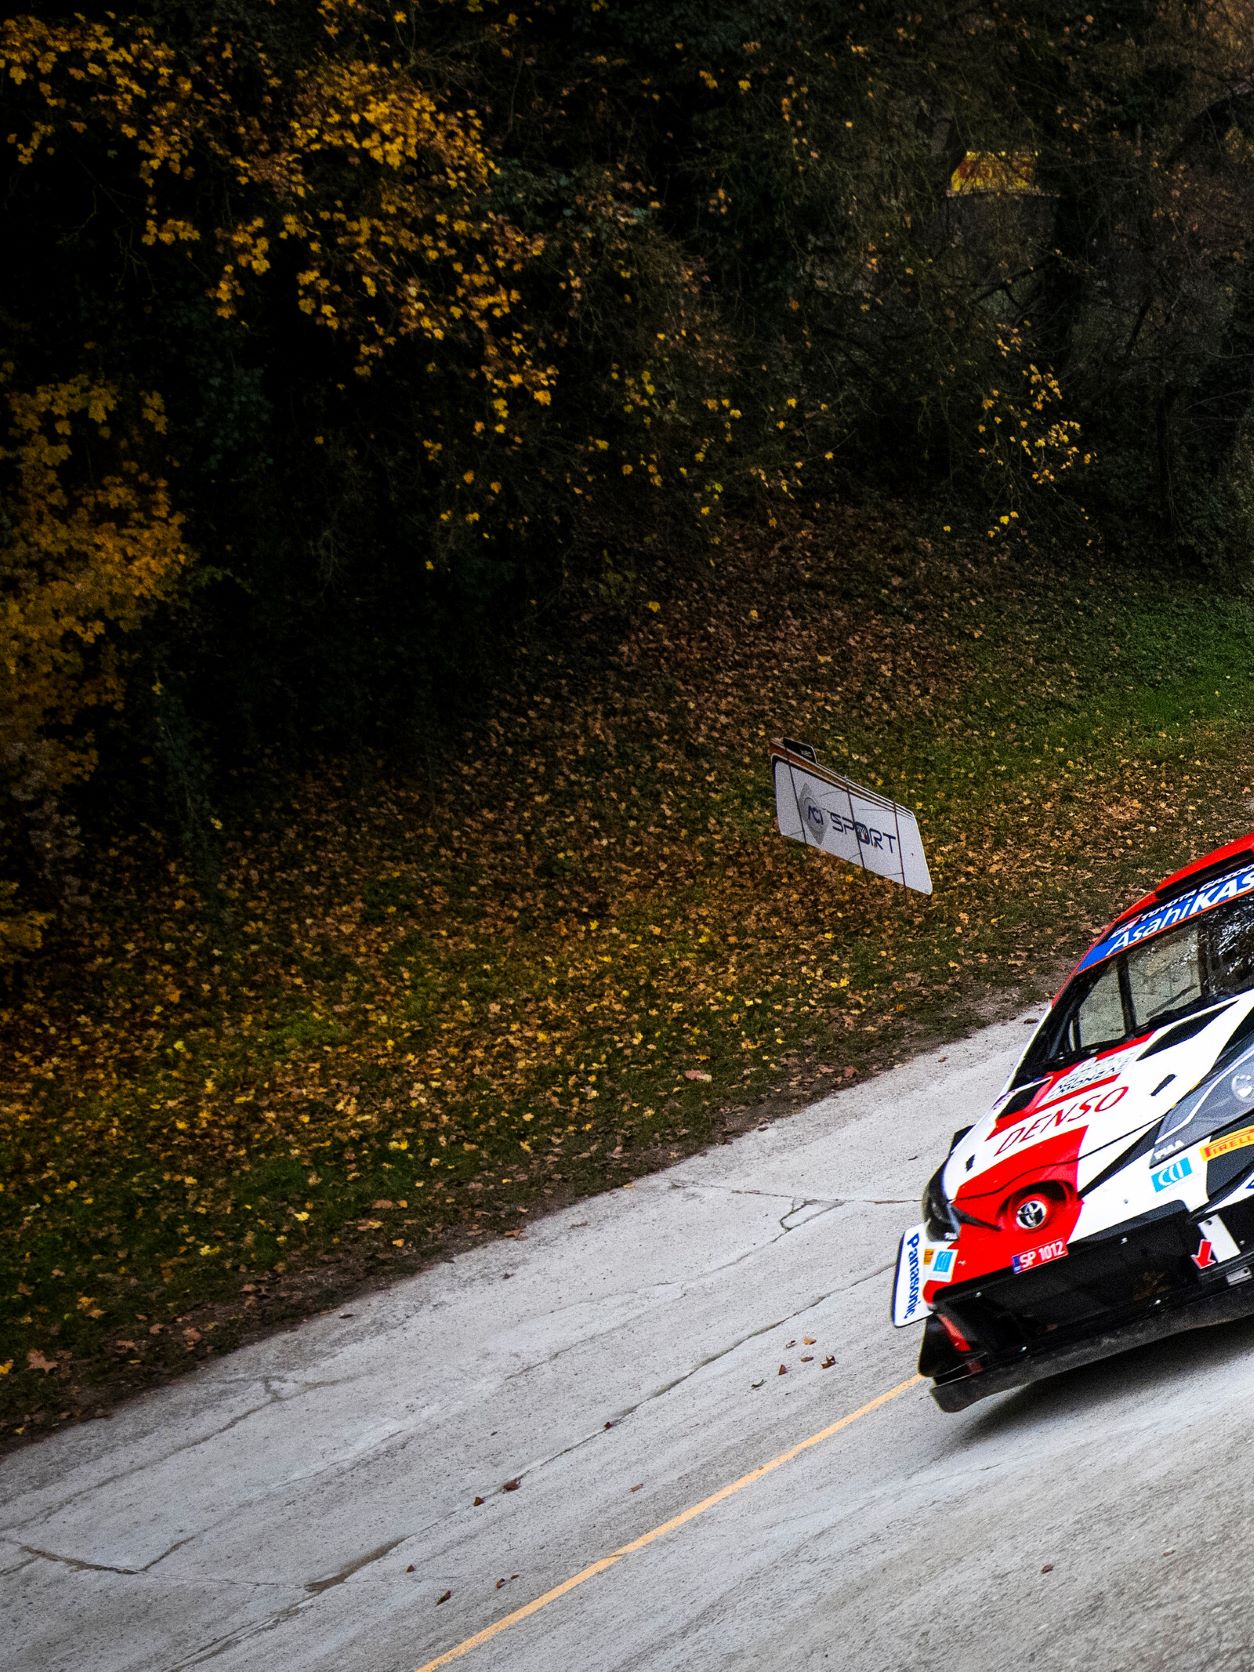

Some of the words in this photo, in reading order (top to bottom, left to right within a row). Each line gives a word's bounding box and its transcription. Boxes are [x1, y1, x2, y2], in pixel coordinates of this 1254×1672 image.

[830, 811, 897, 854] SPORT
[1140, 887, 1197, 922] TOYOTA
[994, 1086, 1129, 1157] DENSO
[904, 1232, 921, 1320] Panasonic
[1019, 1251, 1036, 1269] SP
[1039, 1241, 1066, 1262] 1012
